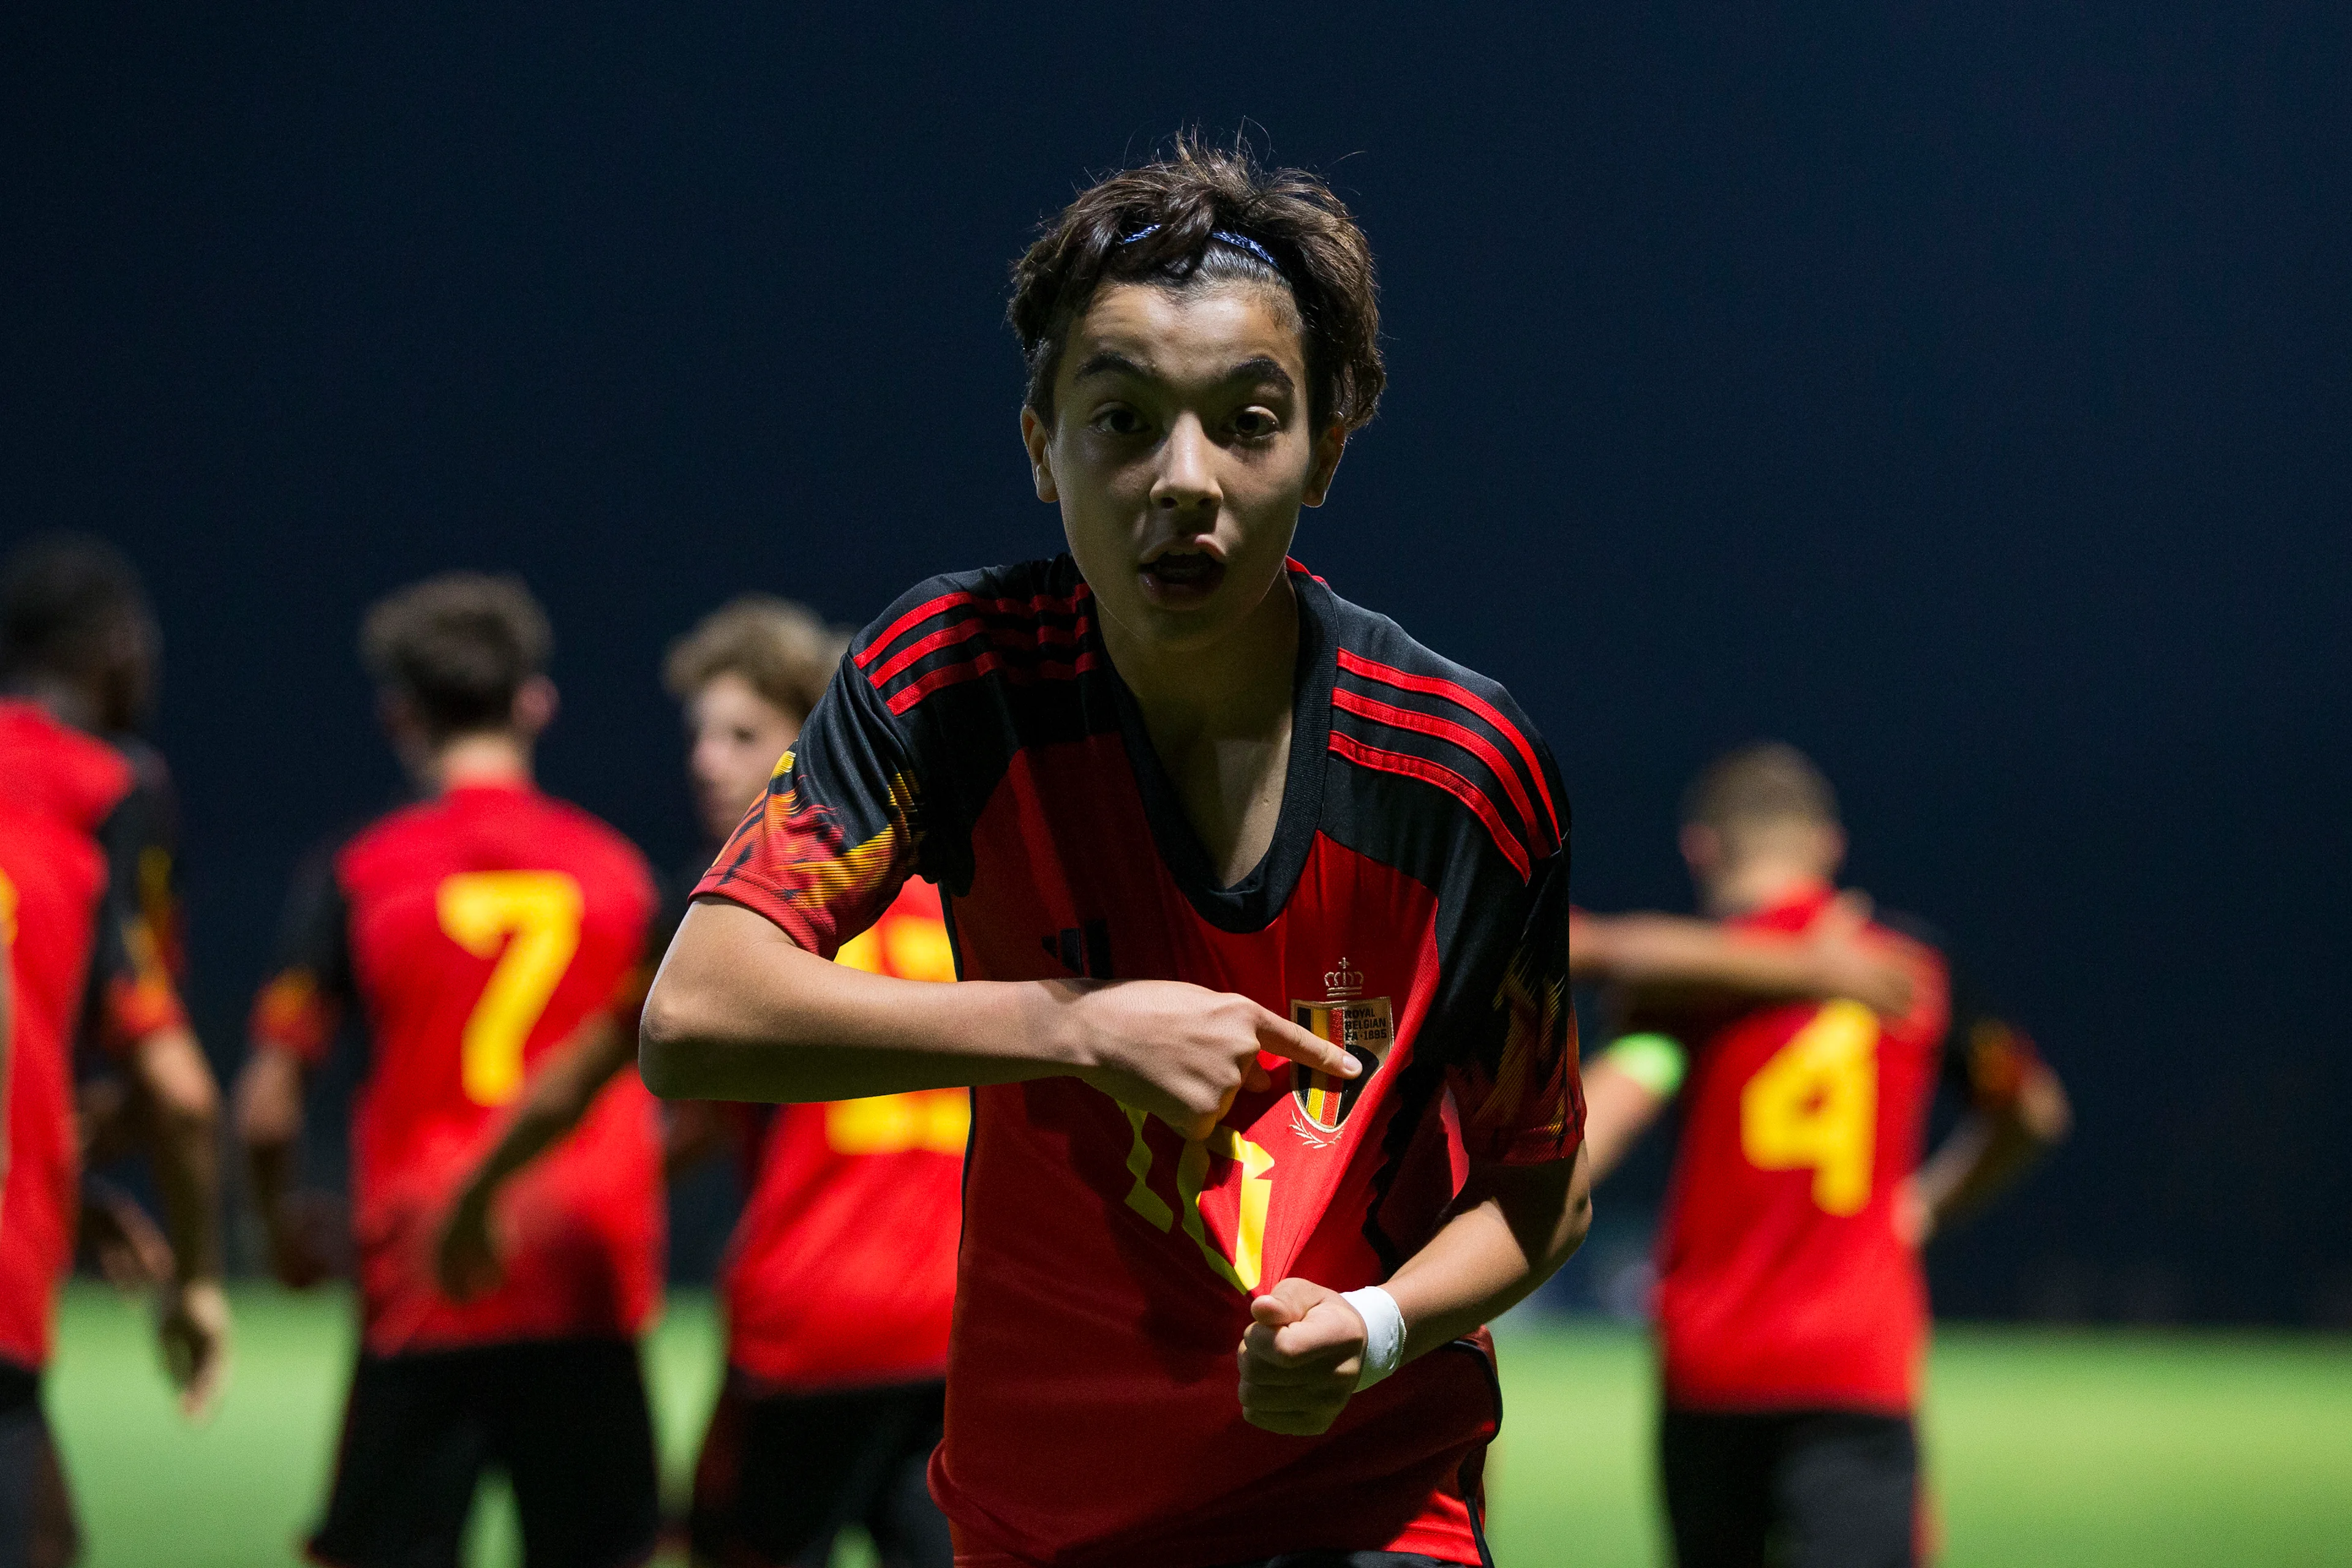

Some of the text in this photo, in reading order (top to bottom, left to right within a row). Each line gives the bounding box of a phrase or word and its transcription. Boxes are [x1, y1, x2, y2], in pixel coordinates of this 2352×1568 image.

[436, 870, 583, 1106] 7
[1345, 1008, 1375, 1019] ROYAL
[1345, 1017, 1386, 1030] BELGIAN
[1740, 998, 1879, 1218] 4
